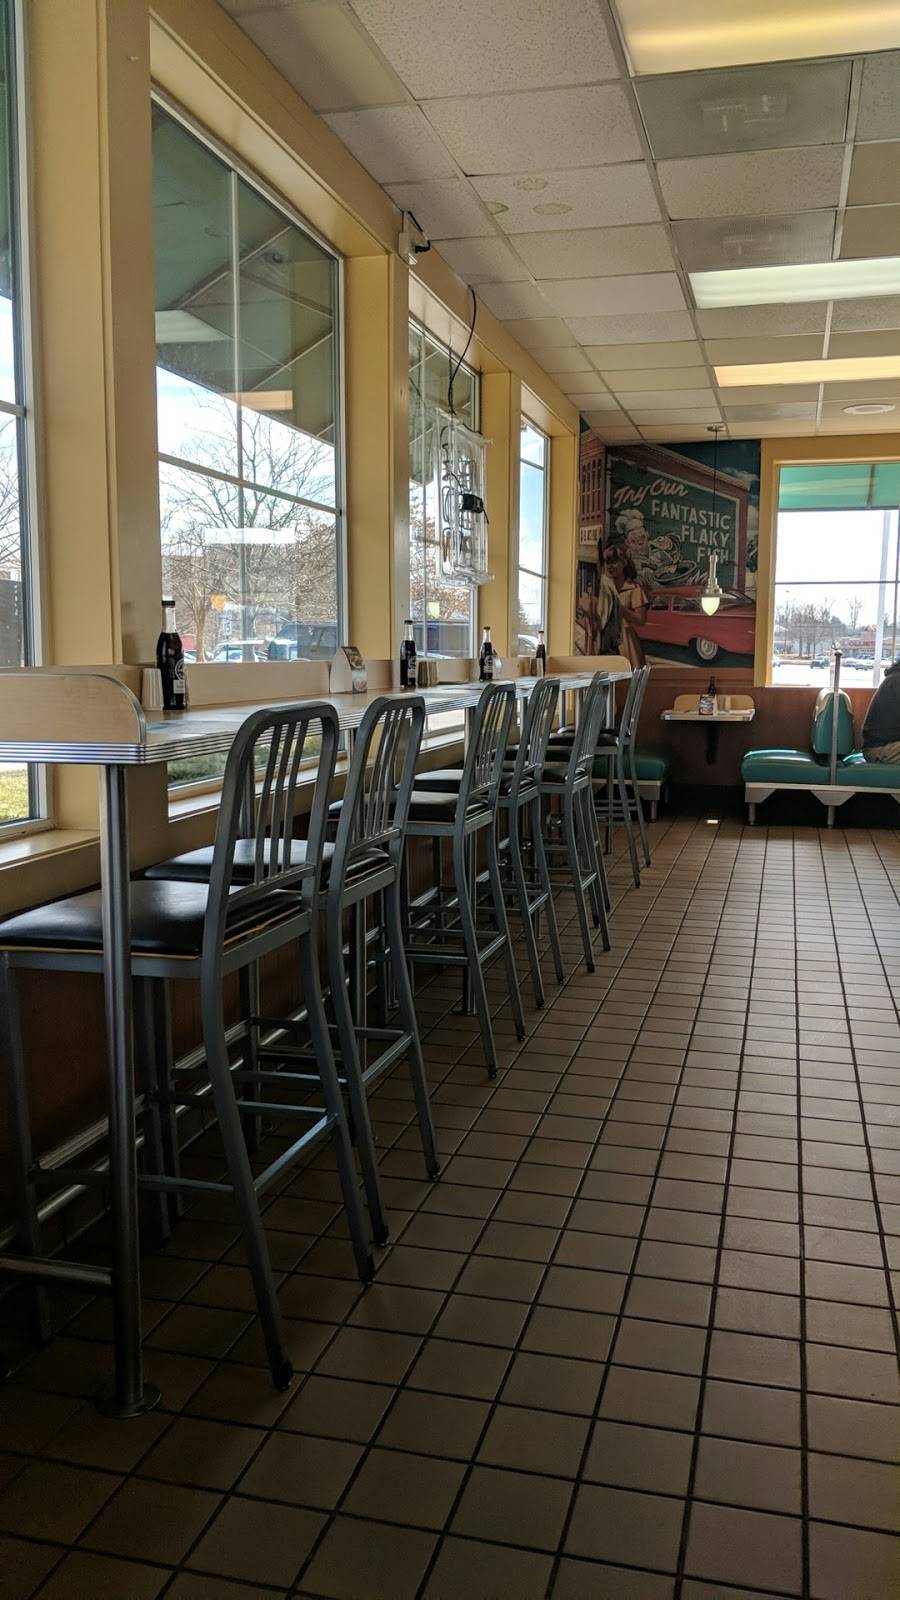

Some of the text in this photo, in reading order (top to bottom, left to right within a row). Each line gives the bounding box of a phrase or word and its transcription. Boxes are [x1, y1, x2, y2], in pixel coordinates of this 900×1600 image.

[614, 479, 688, 508] Try Our
[651, 500, 731, 529] FANTASTIC
[681, 525, 730, 547] FLAKY
